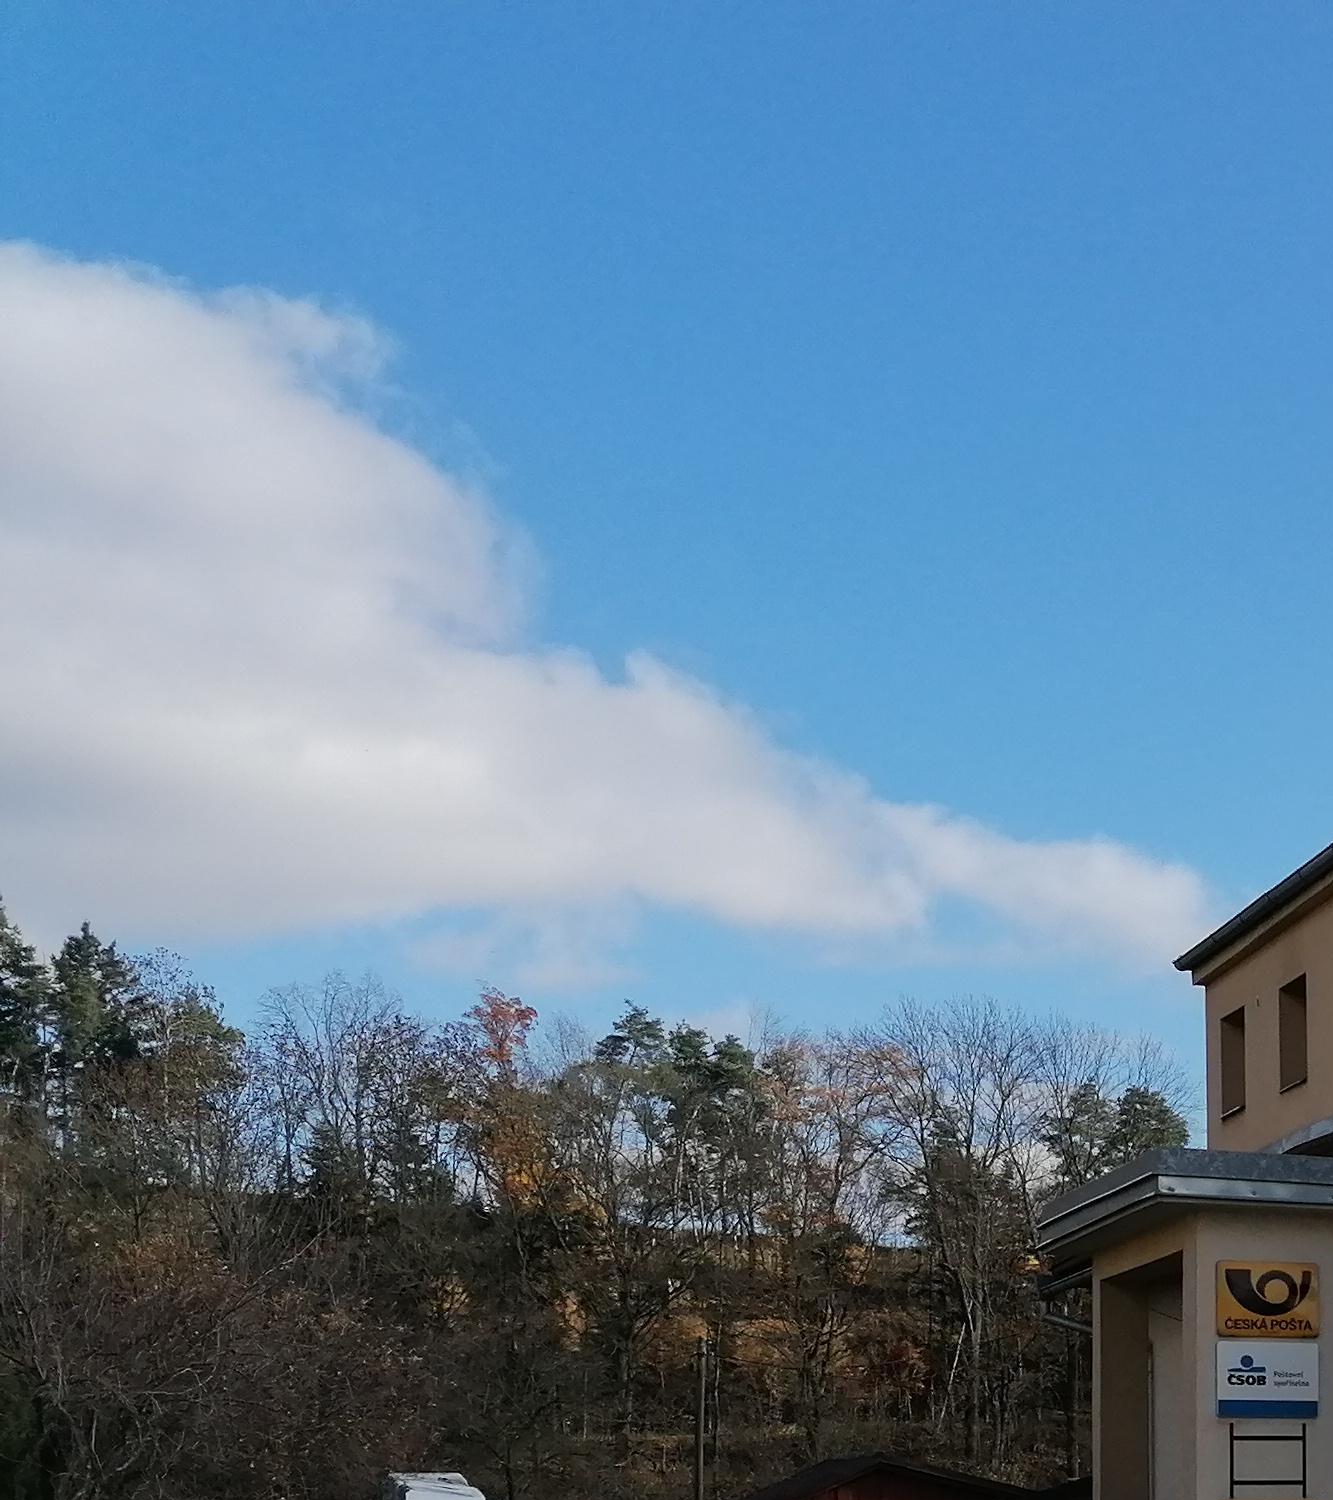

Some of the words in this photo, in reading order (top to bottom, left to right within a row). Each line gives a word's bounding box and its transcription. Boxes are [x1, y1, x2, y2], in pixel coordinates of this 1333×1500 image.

[1225, 1316, 1267, 1330] ČESKÁ
[1270, 1317, 1312, 1331] POŠTA
[1227, 1373, 1266, 1386] ČSOB
